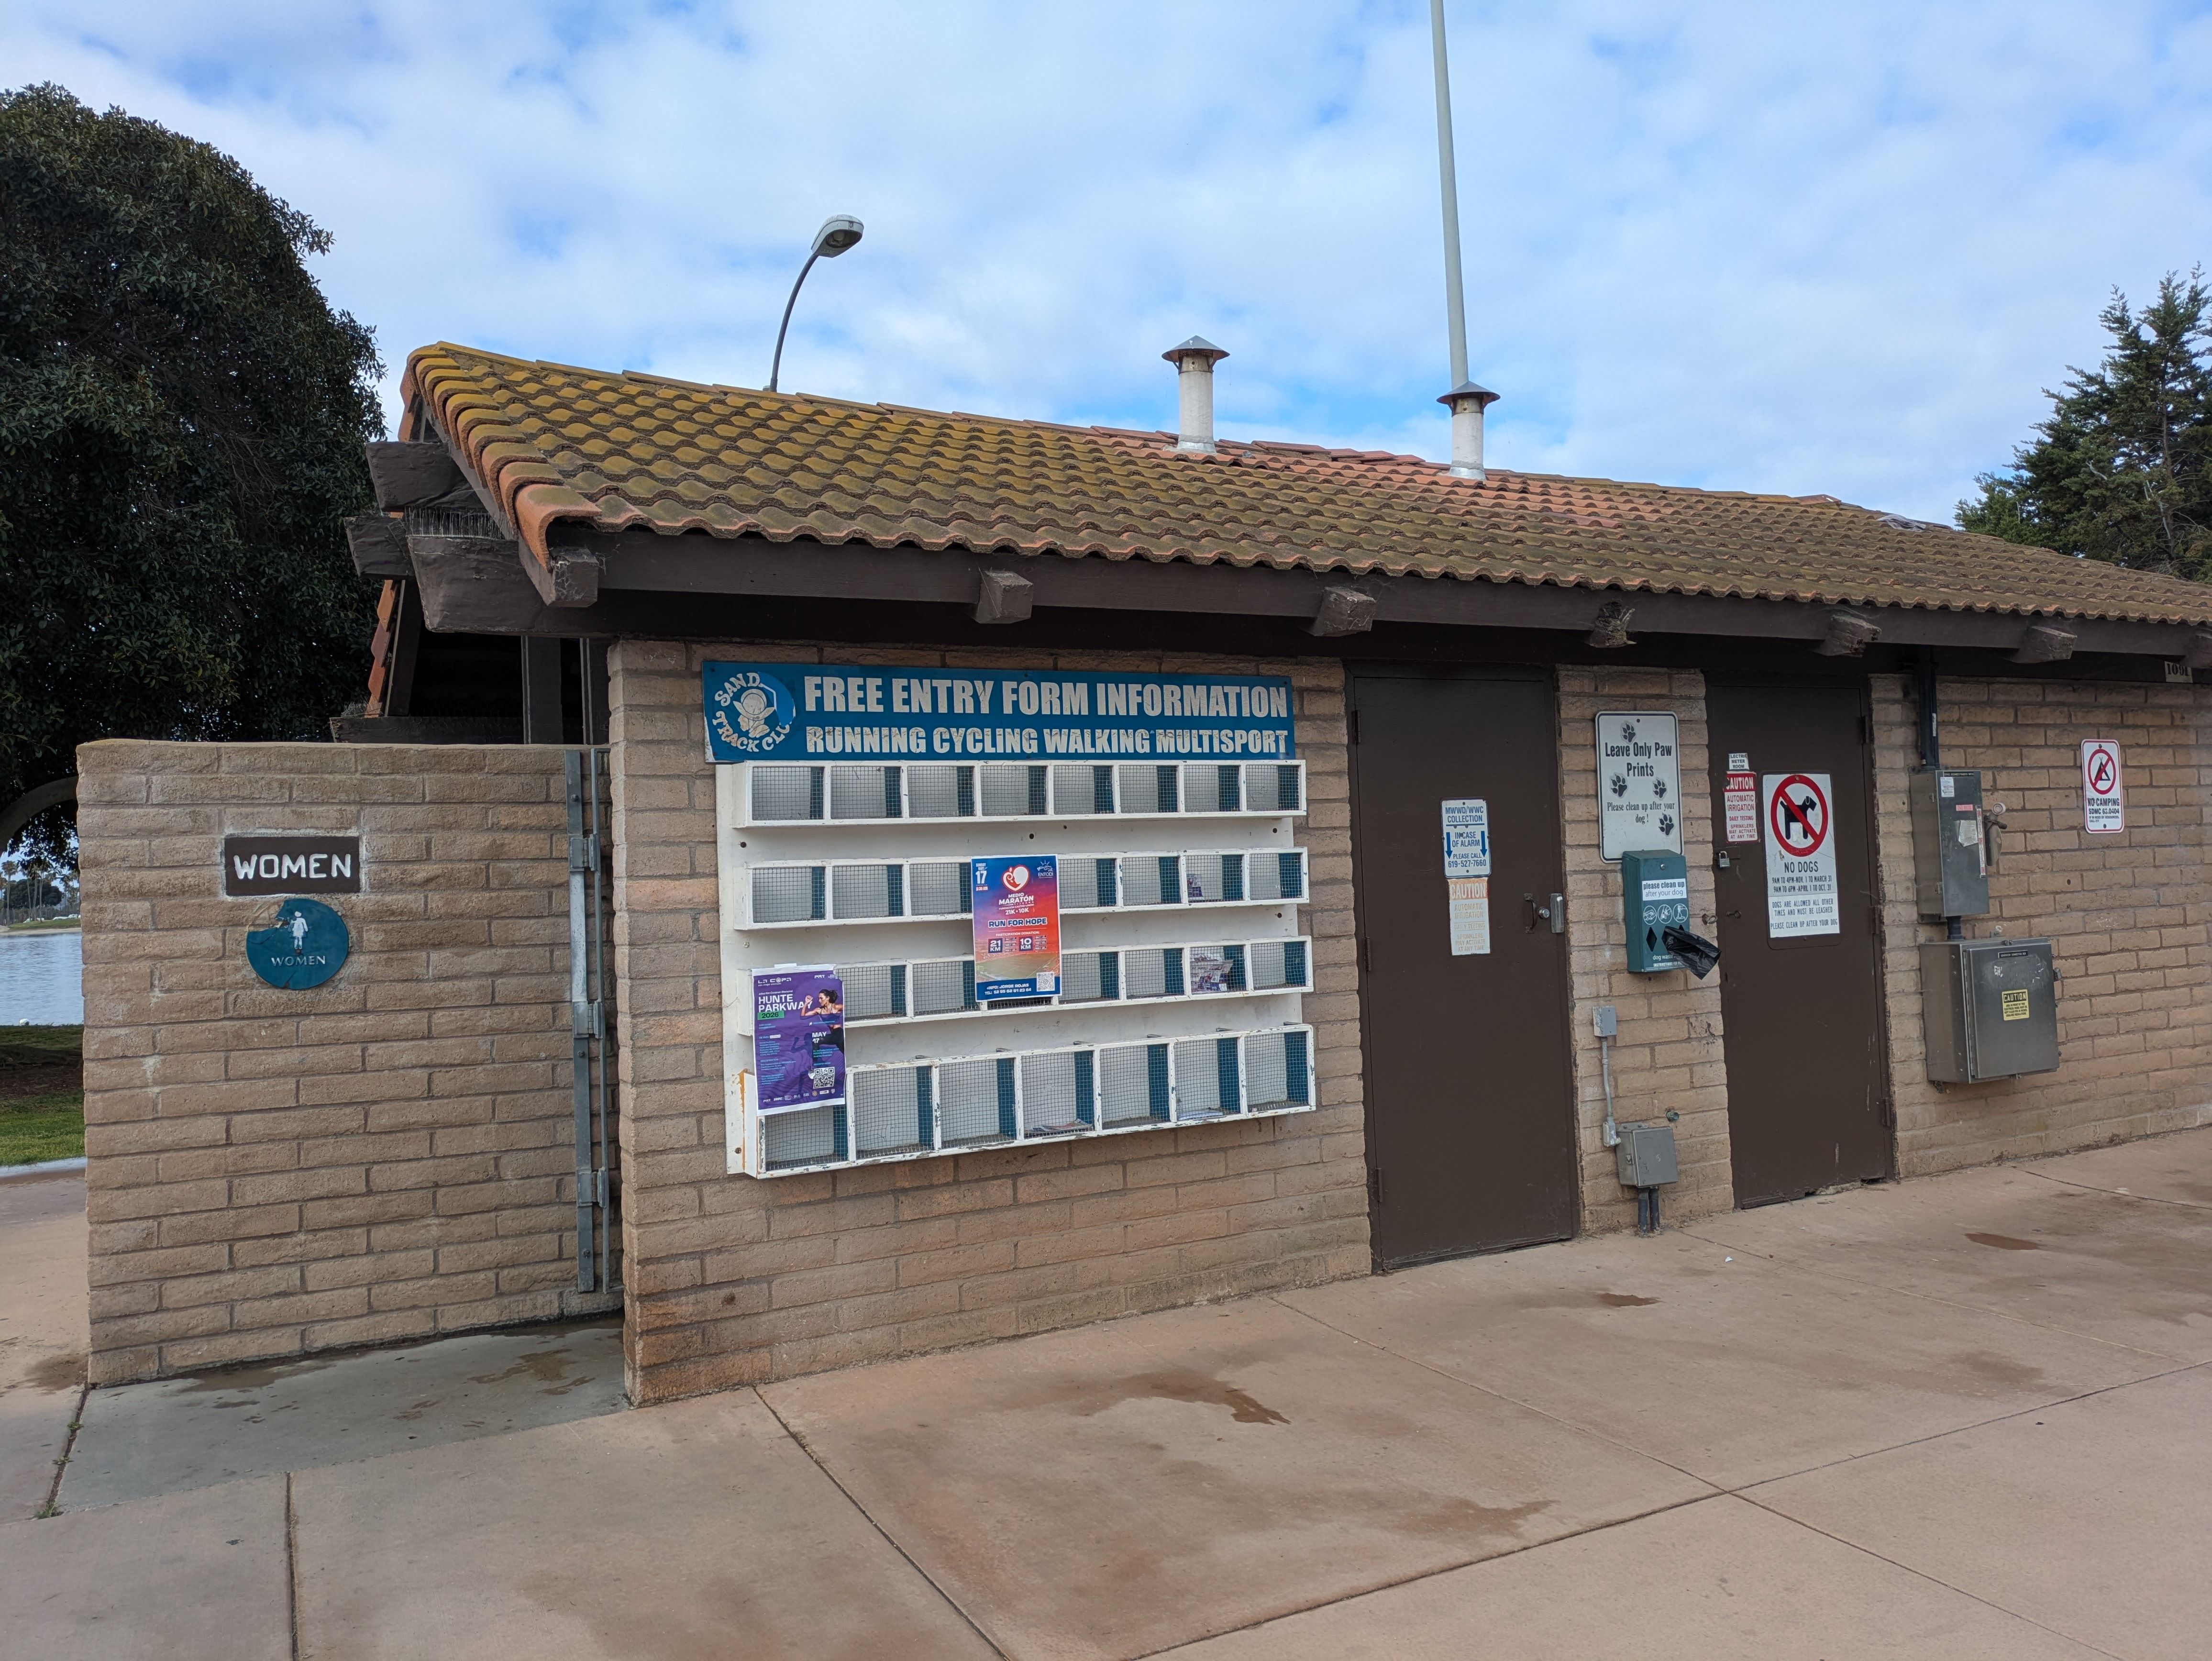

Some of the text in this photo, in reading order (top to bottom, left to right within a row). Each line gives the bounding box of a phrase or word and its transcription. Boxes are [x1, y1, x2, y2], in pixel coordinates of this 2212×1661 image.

[715, 672, 761, 707] SAND
[805, 676, 1287, 718] FREE ENTRY FORM INFORMATION
[712, 711, 792, 752] TRACK CLU
[806, 726, 1288, 753] RUNNING CYCLING WALKING MULTISPORT
[1605, 742, 1672, 759] Leave Only Paw
[1626, 763, 1654, 776] Prints
[1607, 801, 1675, 812] Please clean up after your
[2088, 798, 2120, 806] NO CAMPING
[1445, 806, 1483, 814] MWWD/WWC
[1448, 815, 1482, 823] COLLECTION
[1636, 814, 1645, 824] dog
[233, 854, 351, 879] WOMEN
[1448, 859, 1486, 868] 619-527-7660
[1784, 861, 1818, 873] NO DOGS
[975, 871, 987, 884] 17
[1450, 883, 1486, 899] CAUTION
[999, 895, 1034, 905] MARATÓN
[1455, 903, 1483, 911] AUTOMATIC
[988, 918, 1047, 928] RUN FOR HOPE
[271, 956, 326, 966] WOMEN
[759, 994, 793, 1004] HUNTE
[2004, 993, 2026, 1001] CAUTION
[759, 1001, 812, 1013] PARKWAY
